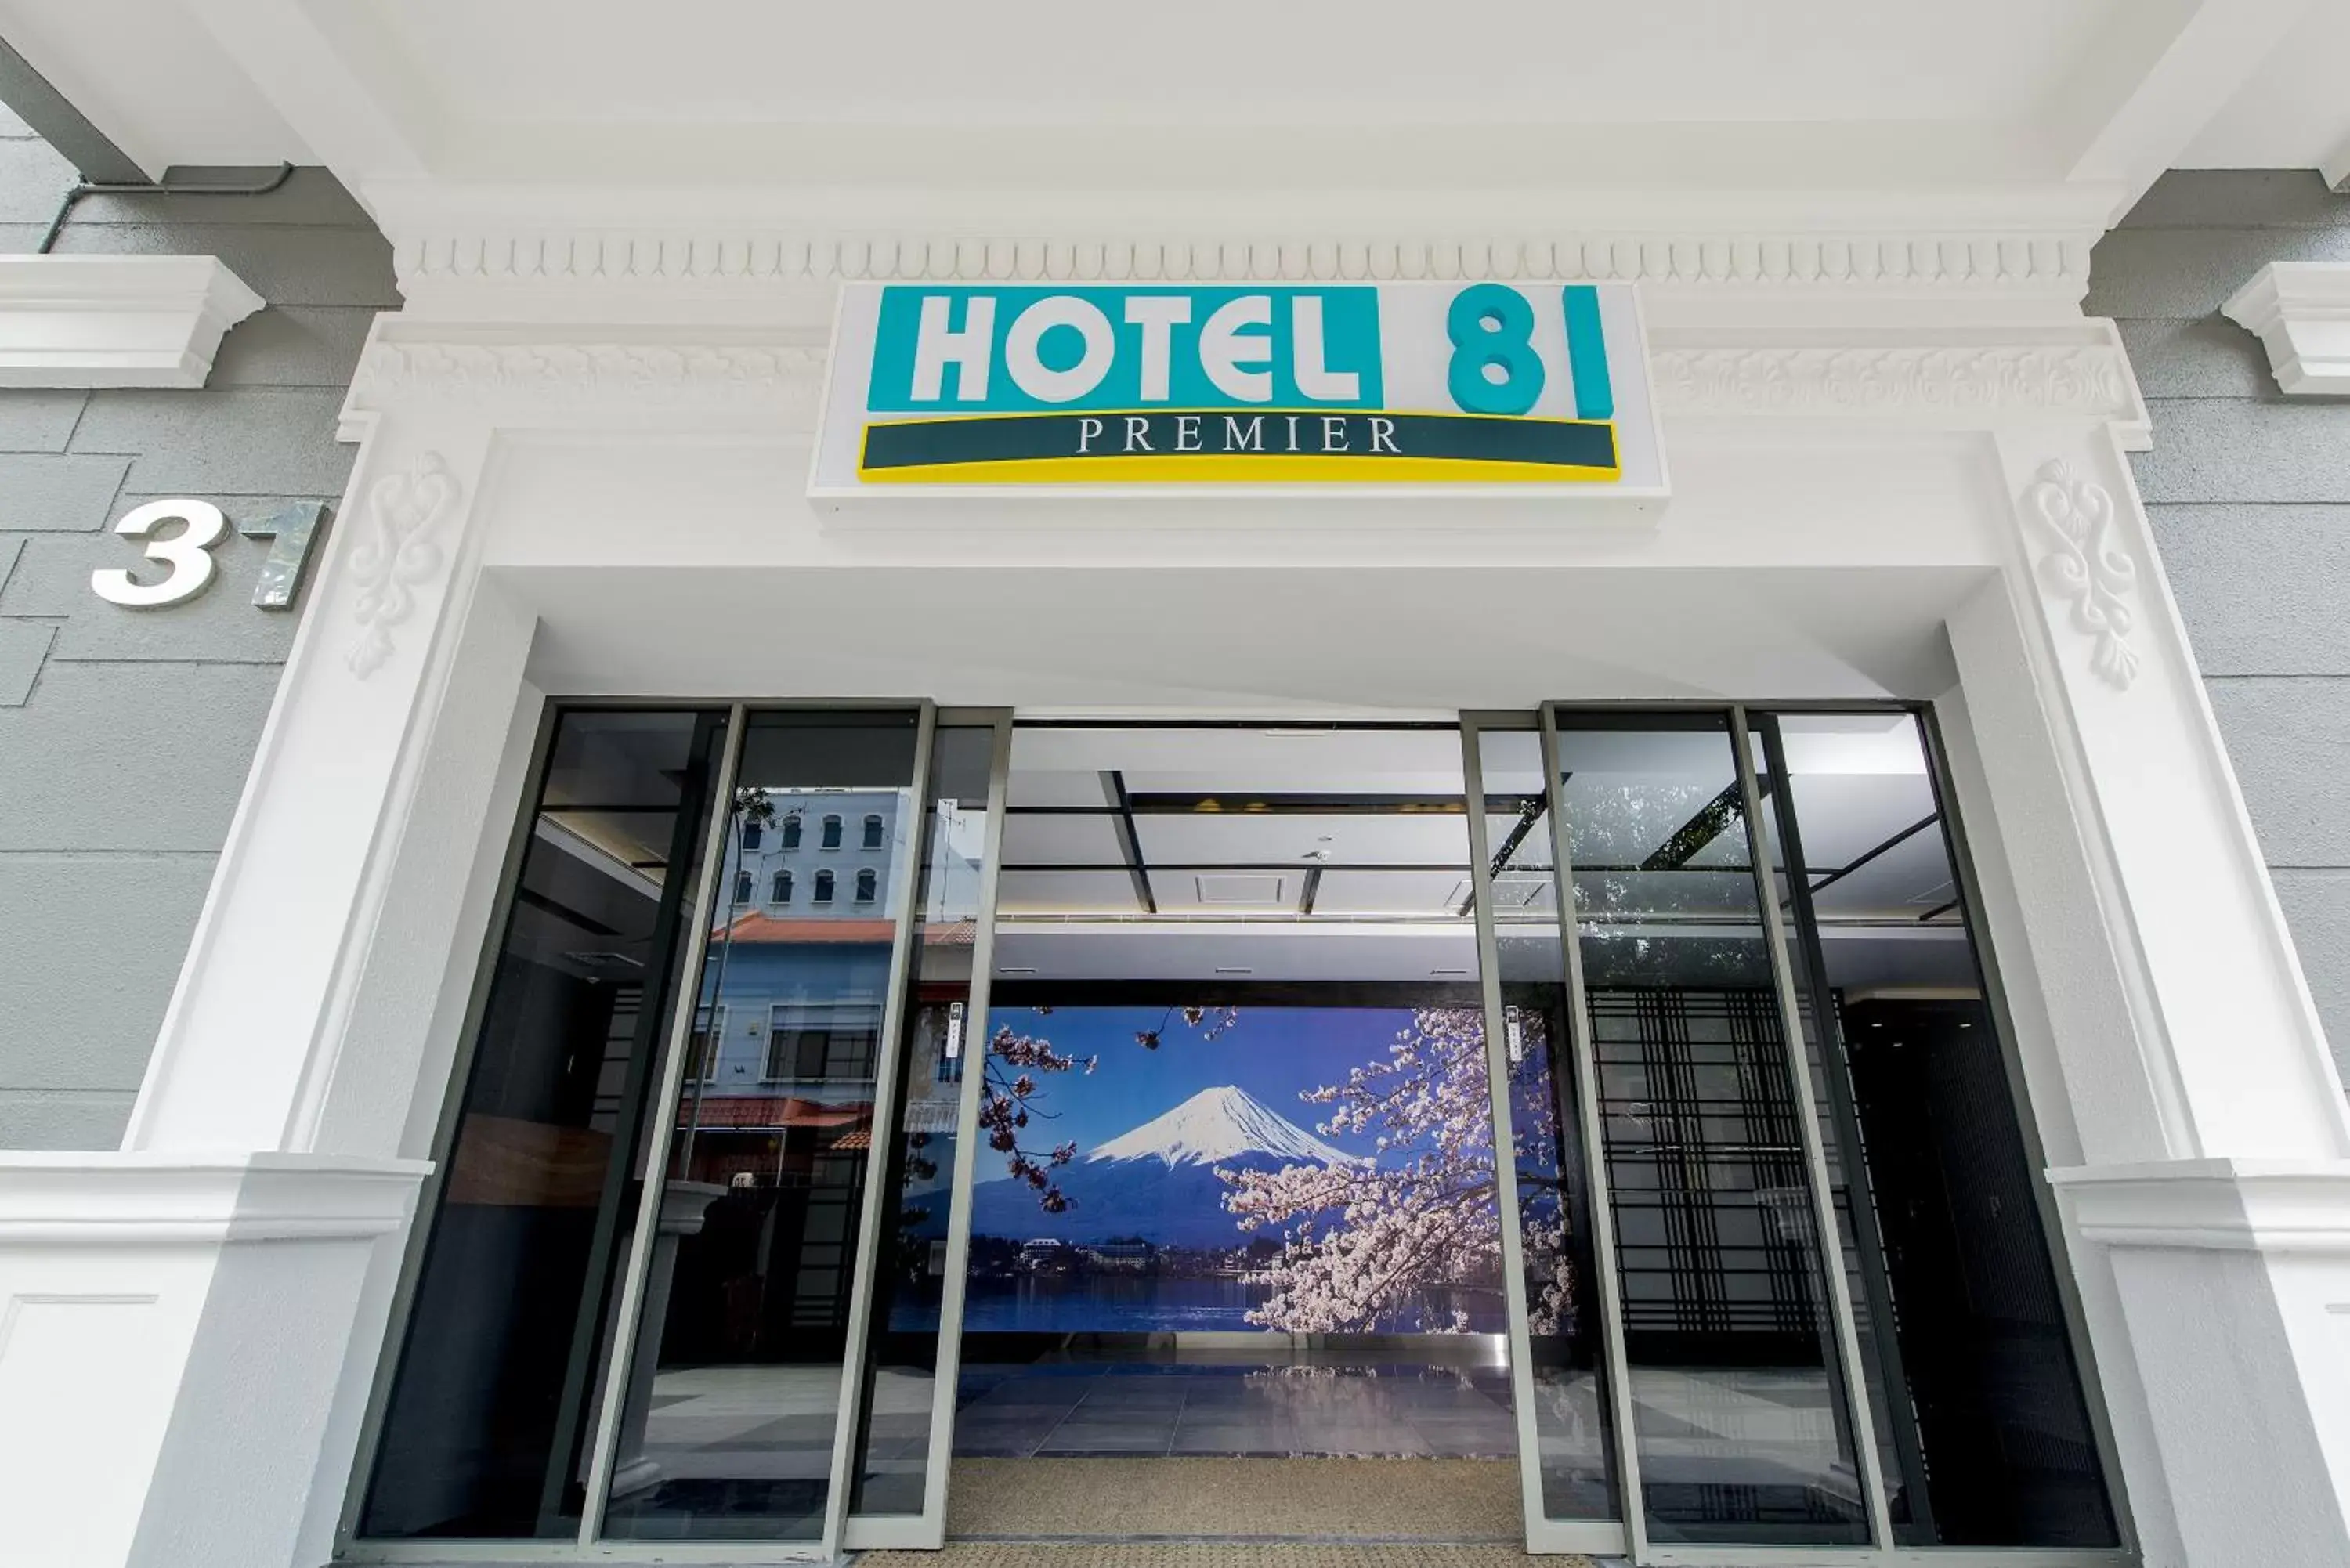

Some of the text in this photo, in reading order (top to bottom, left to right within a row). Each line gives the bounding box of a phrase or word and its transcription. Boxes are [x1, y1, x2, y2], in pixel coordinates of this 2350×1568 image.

[910, 283, 1614, 420] HOTEL 81
[1076, 417, 1403, 454] PREMIER
[91, 498, 326, 609] 37
